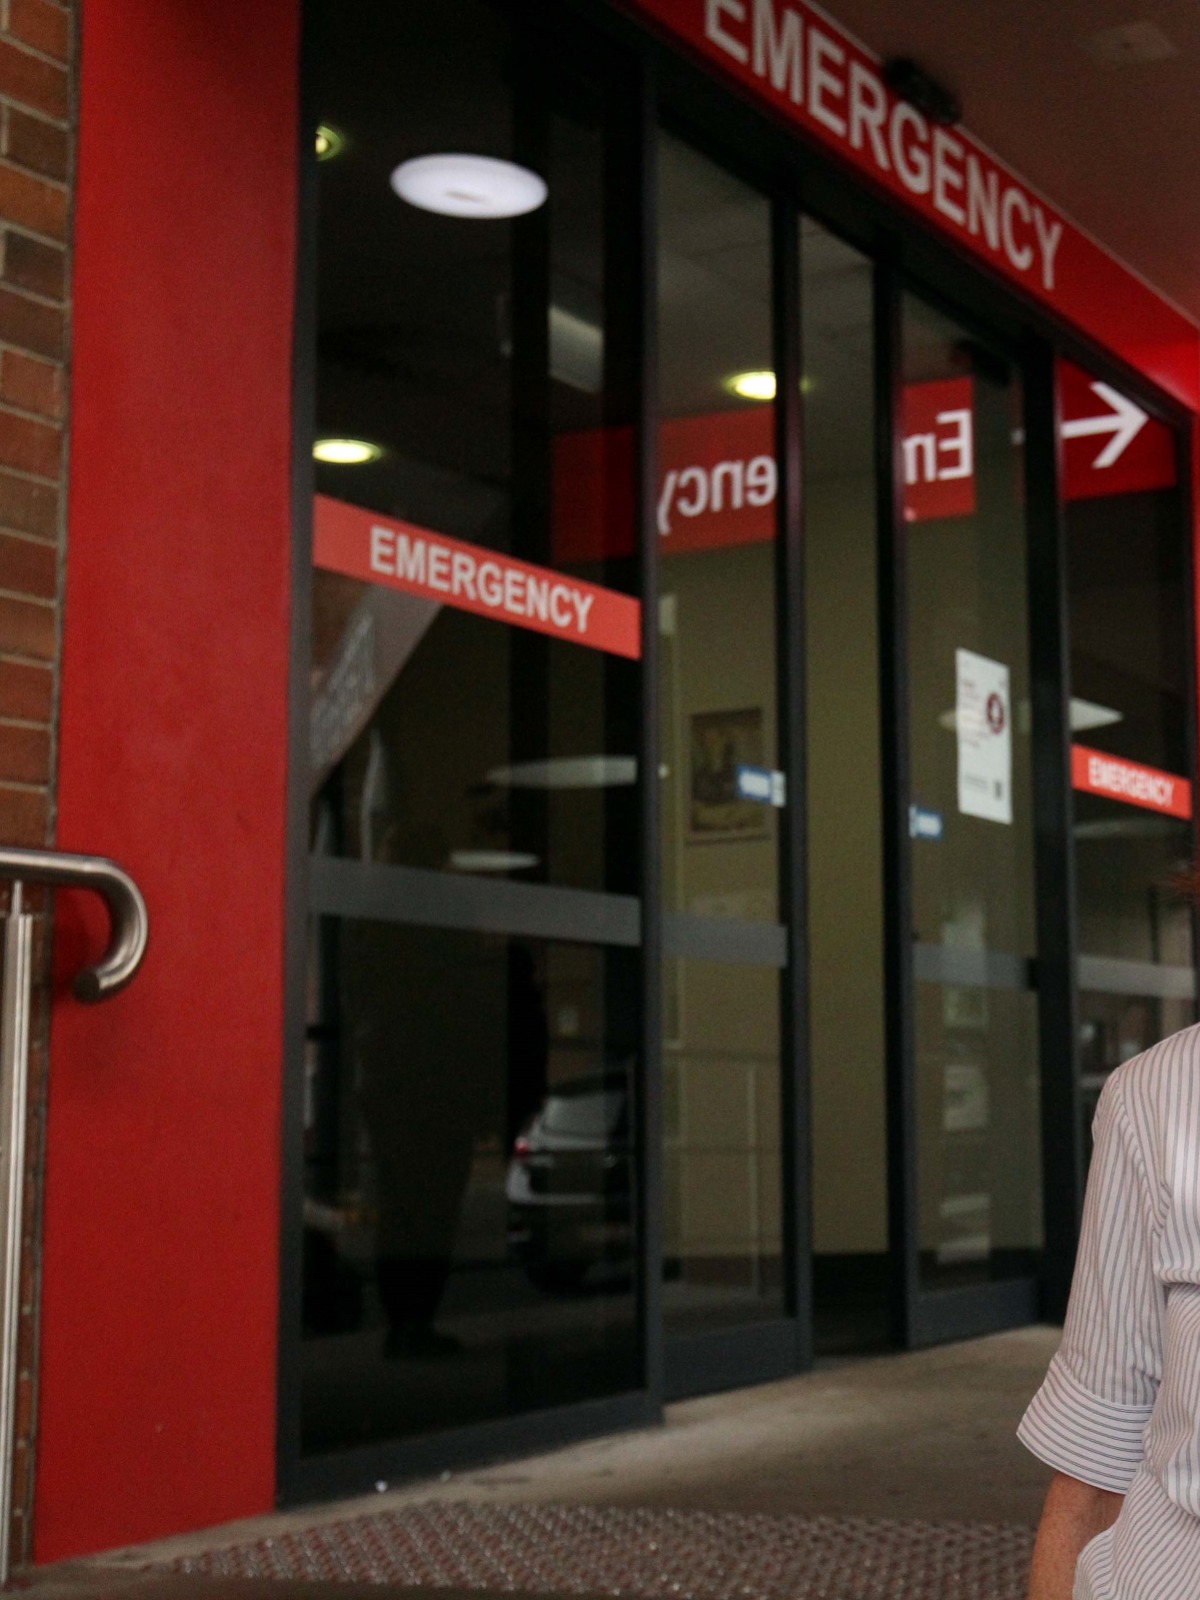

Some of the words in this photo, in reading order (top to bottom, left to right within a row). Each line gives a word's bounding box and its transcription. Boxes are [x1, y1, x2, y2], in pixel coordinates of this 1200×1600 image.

[705, 0, 1063, 290] EMERGENCY
[369, 524, 594, 634] EMERGENCY
[1087, 755, 1174, 808] EMERGENCY
